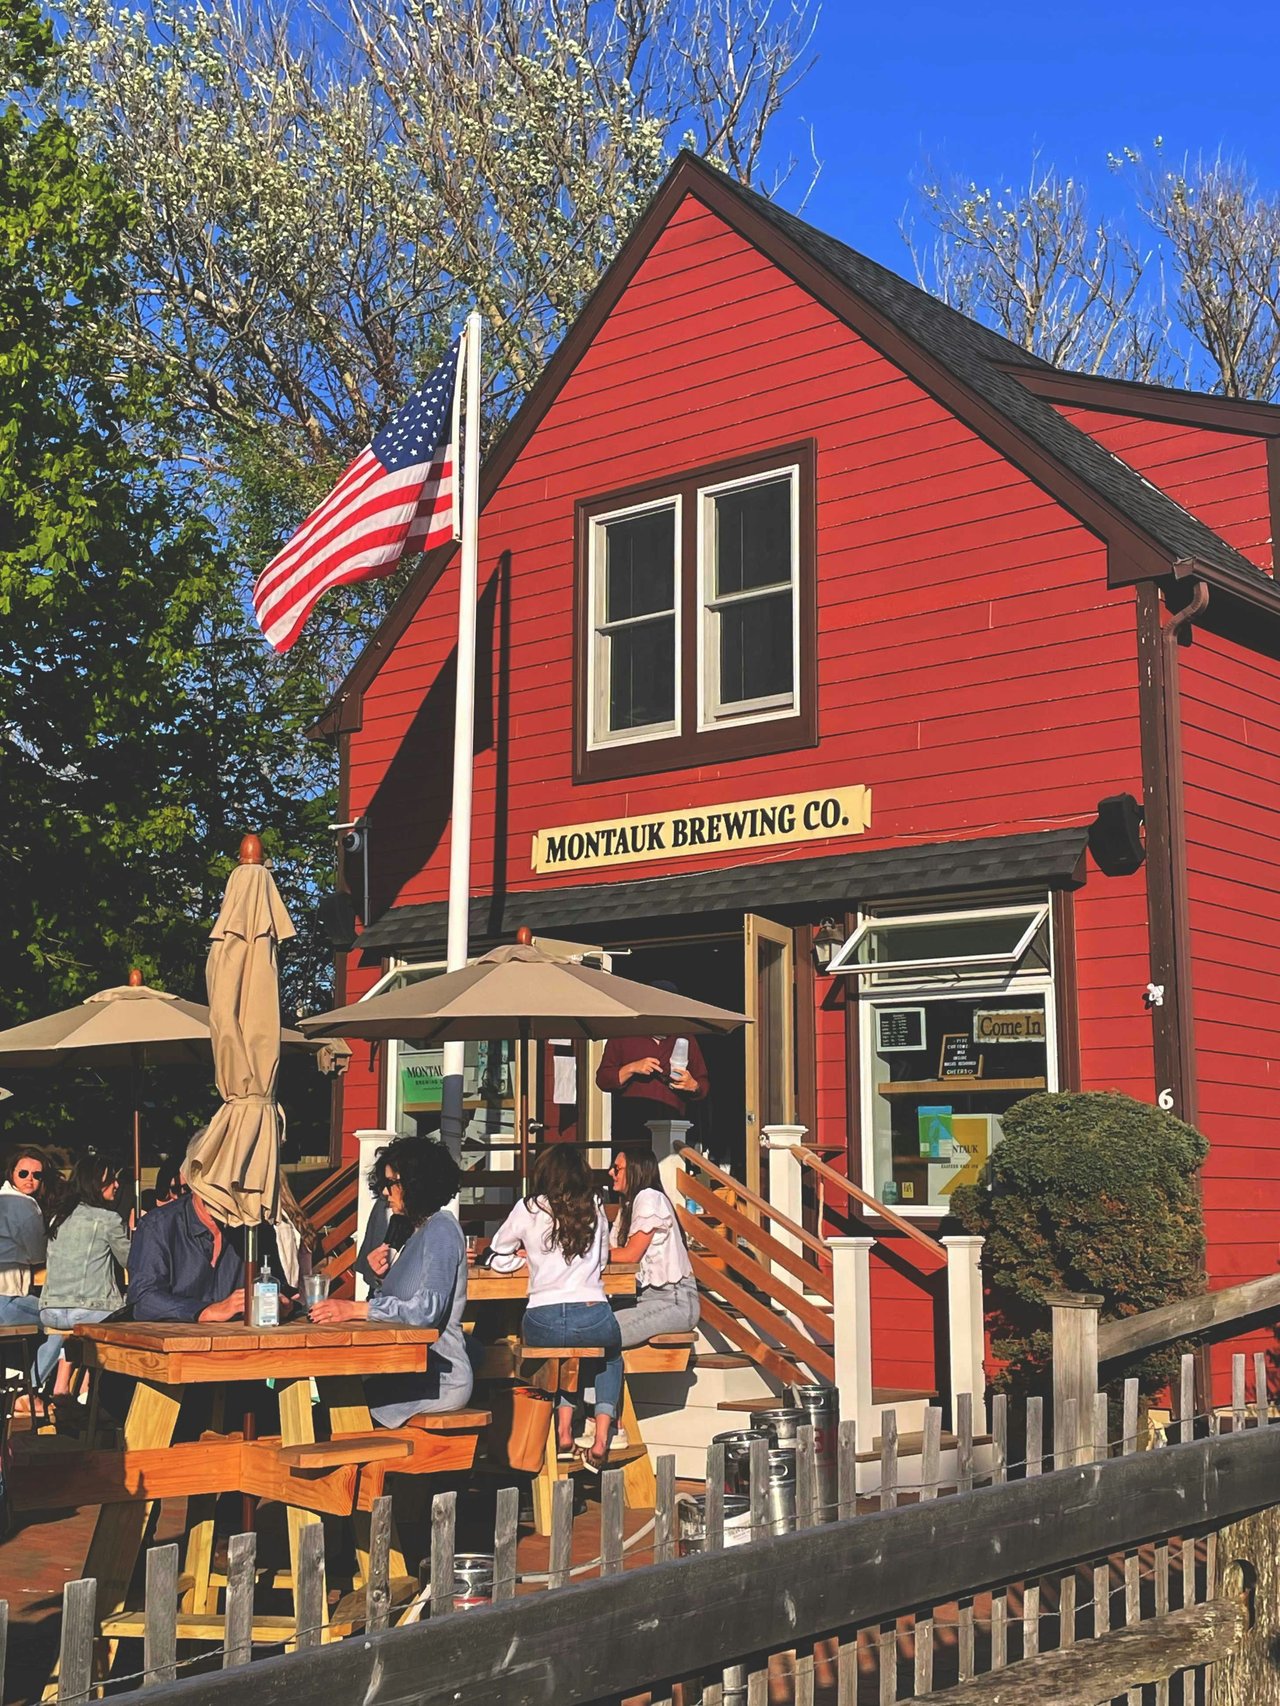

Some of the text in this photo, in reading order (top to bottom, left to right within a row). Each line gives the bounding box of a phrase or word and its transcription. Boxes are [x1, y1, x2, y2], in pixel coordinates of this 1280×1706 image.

[546, 798, 849, 862] MONTAUK BREWING CO.
[980, 1016, 1041, 1036] Come In
[1158, 1088, 1174, 1110] 6
[952, 1144, 979, 1154] NTAUK
